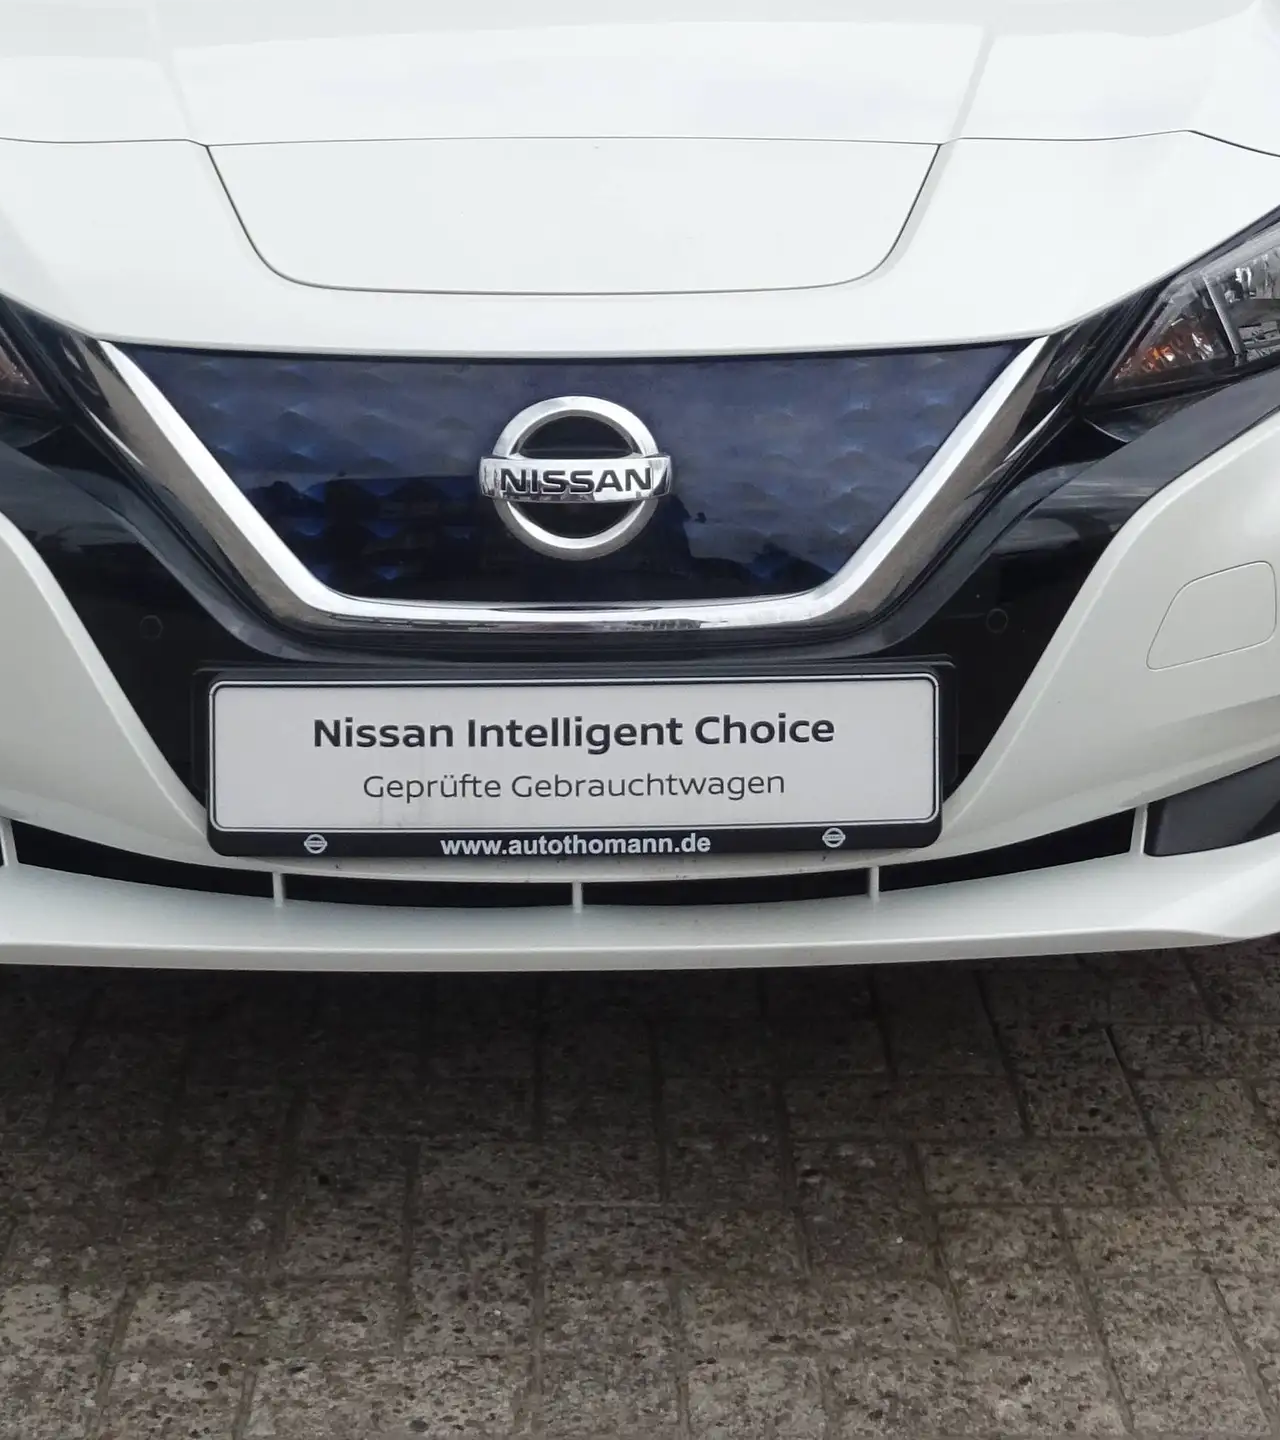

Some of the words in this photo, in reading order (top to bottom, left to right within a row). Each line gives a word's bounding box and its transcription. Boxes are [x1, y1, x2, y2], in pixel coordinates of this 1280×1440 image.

[500, 468, 652, 494] NISSAN
[314, 716, 454, 748] Nissan
[468, 714, 683, 756] Intelligent
[695, 712, 835, 745] Choice
[363, 773, 502, 803] Geprüfte
[511, 771, 786, 801] Gebrauchtwagen
[440, 833, 712, 856] www.autothomann.de
